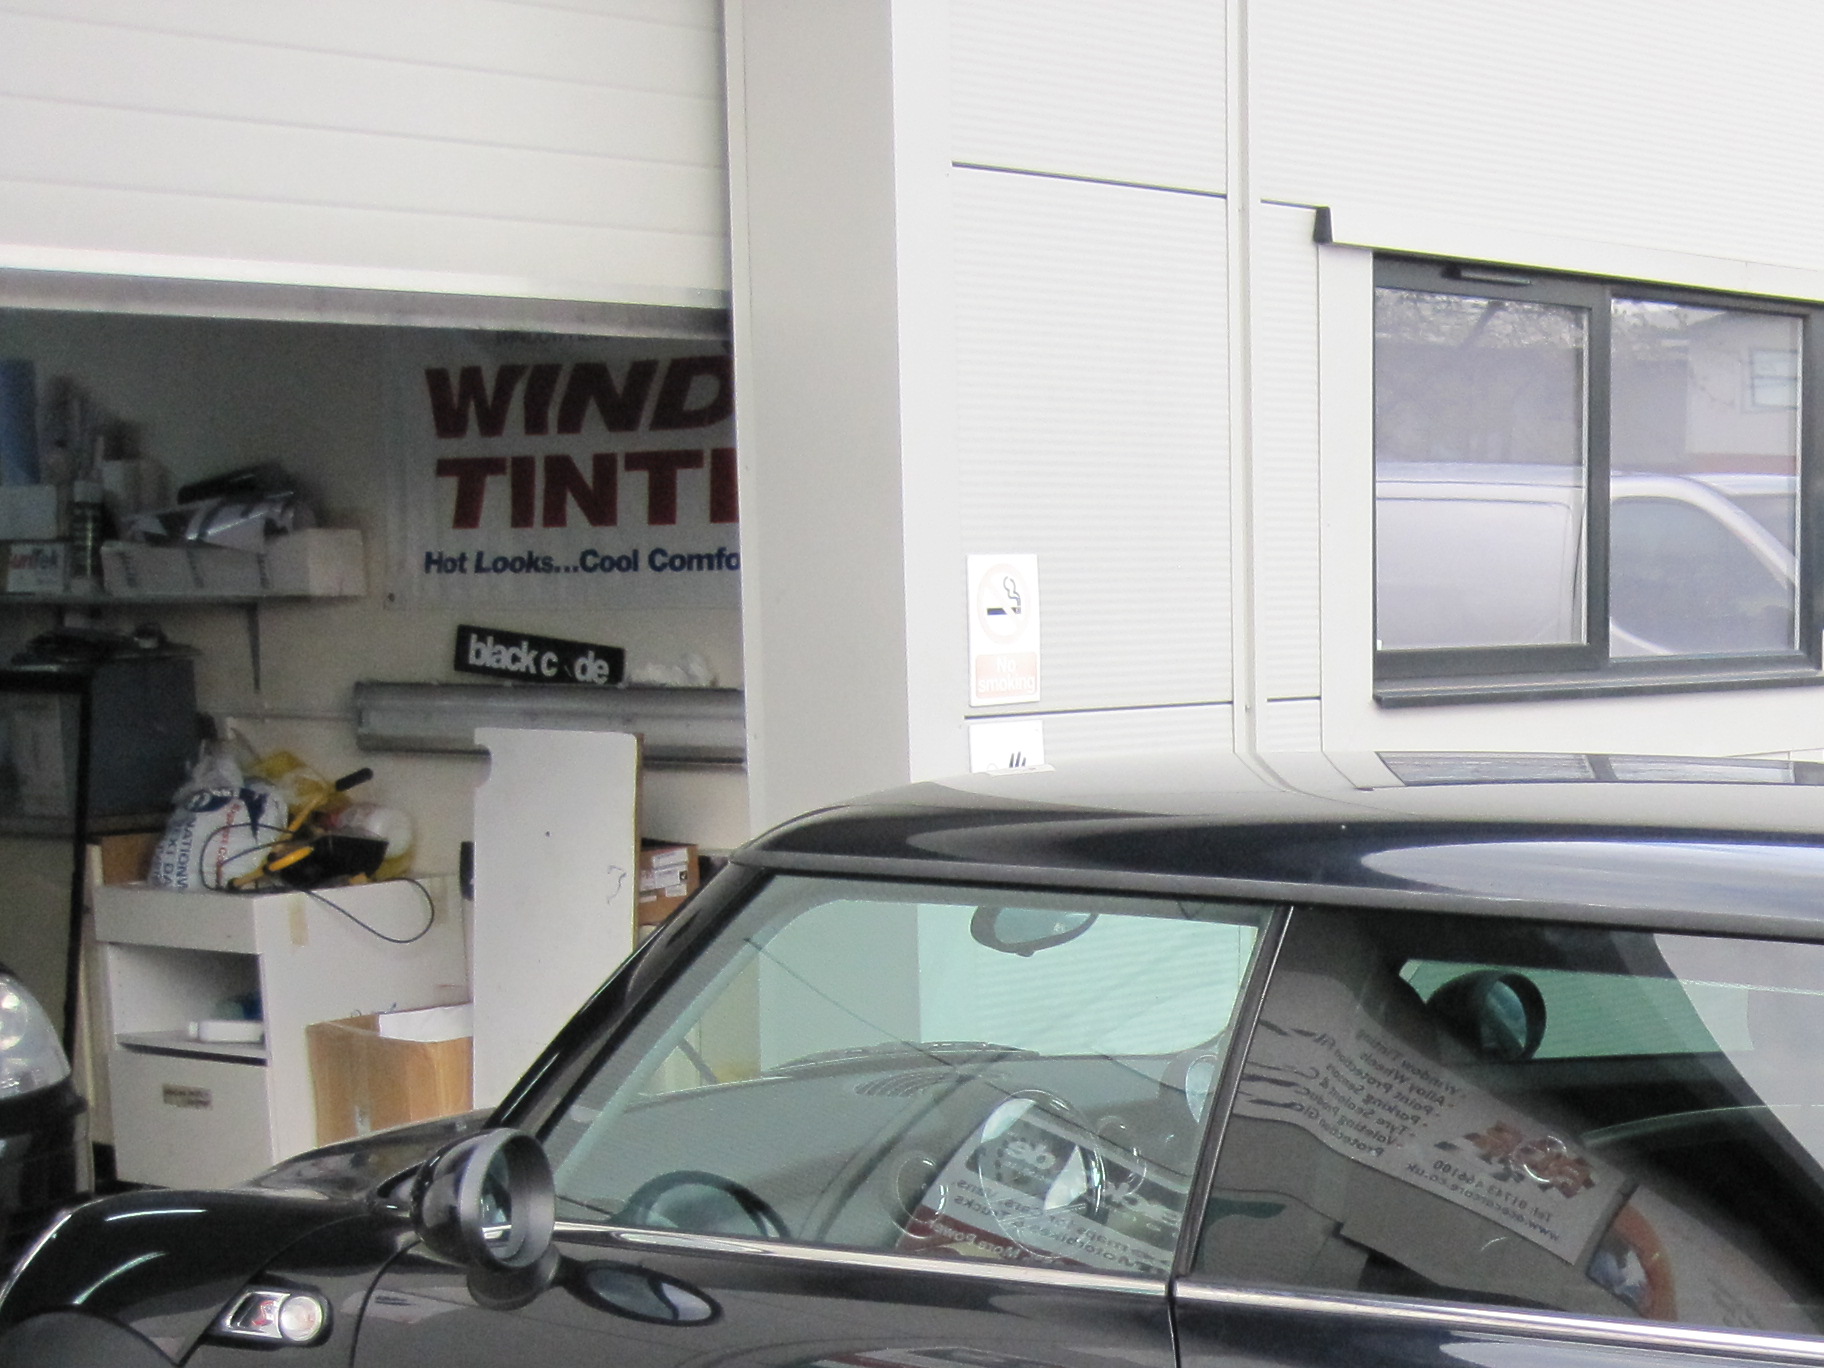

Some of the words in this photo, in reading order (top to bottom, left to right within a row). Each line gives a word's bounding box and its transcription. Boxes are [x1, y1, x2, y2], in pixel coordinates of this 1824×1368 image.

[424, 355, 736, 439] WIND
[436, 447, 740, 530] TINTI
[424, 551, 468, 575] Hot
[648, 547, 741, 573] Comfo
[468, 632, 538, 675] black
[996, 655, 1017, 674] No
[977, 674, 1036, 694] smoking
